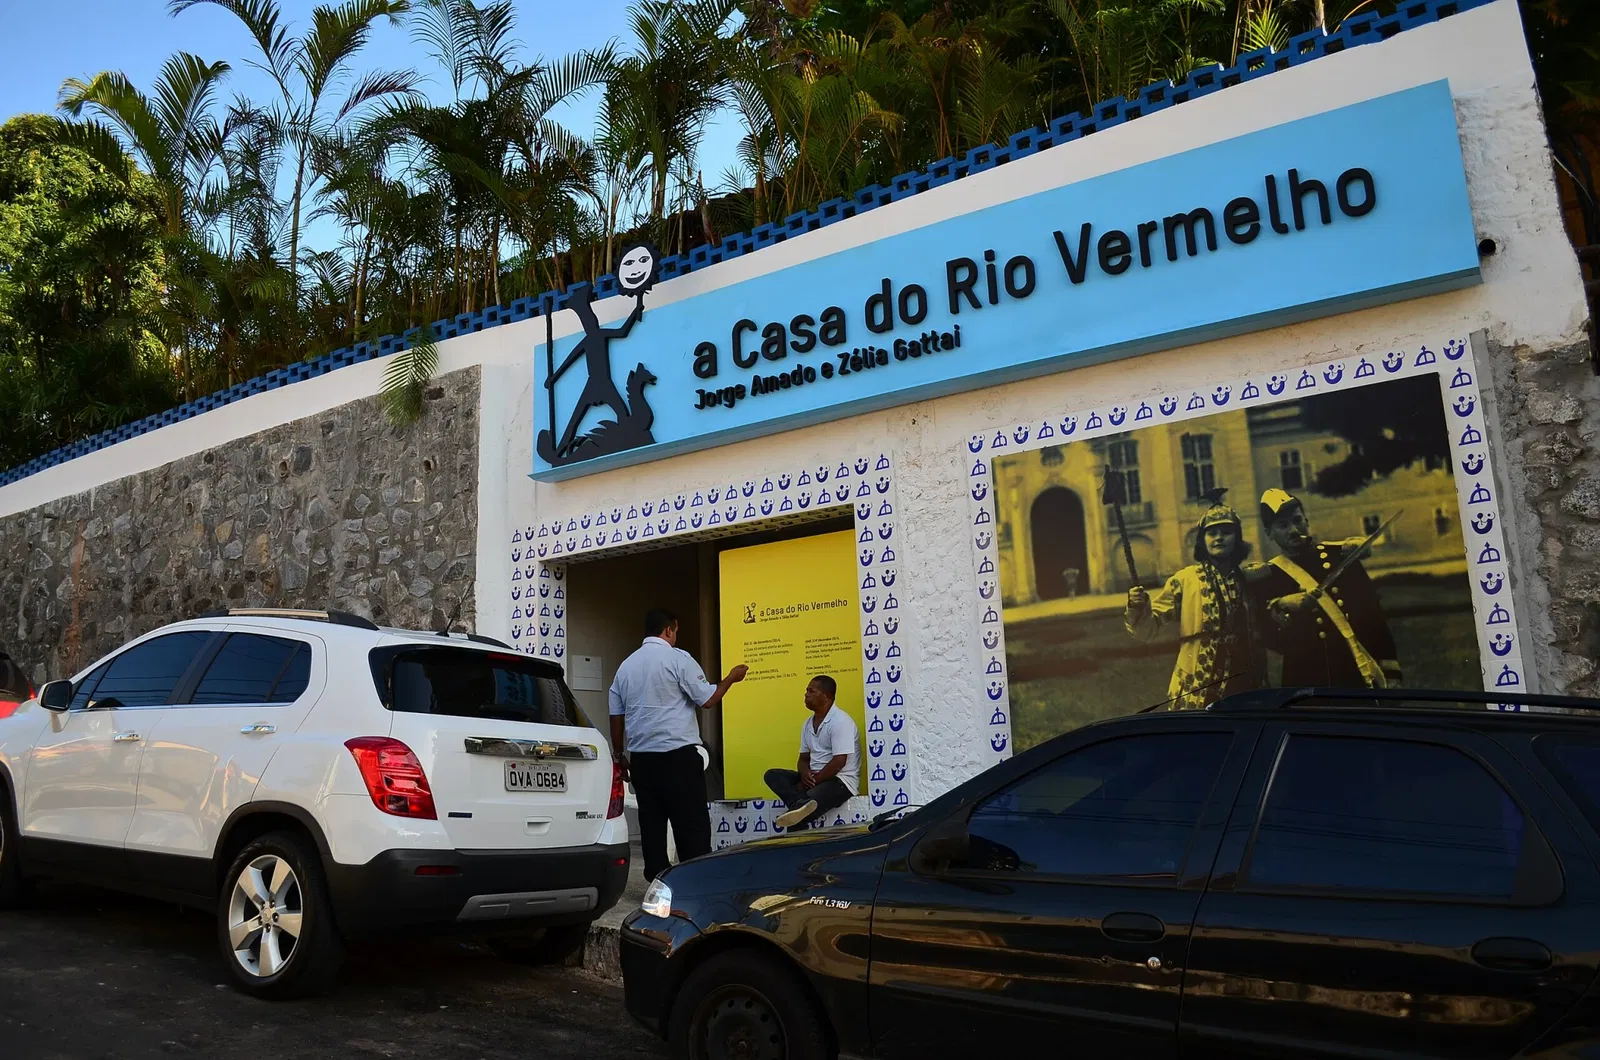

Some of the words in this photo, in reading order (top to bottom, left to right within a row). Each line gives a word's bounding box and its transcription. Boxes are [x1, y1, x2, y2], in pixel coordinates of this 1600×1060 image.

[692, 341, 719, 380] a
[731, 306, 847, 370] Casa
[864, 277, 929, 335] do
[945, 249, 1037, 316] Rio
[1052, 167, 1377, 286] Vermelho
[694, 382, 747, 411] Jorge
[750, 363, 817, 398] Amado
[820, 361, 835, 380] e
[837, 345, 890, 376] Zélia
[893, 324, 961, 362] Gattai
[766, 606, 785, 617] Casa
[786, 604, 796, 614] do
[797, 602, 810, 613] Rio
[811, 598, 848, 611] Vermelho
[809, 896, 824, 905] Fire
